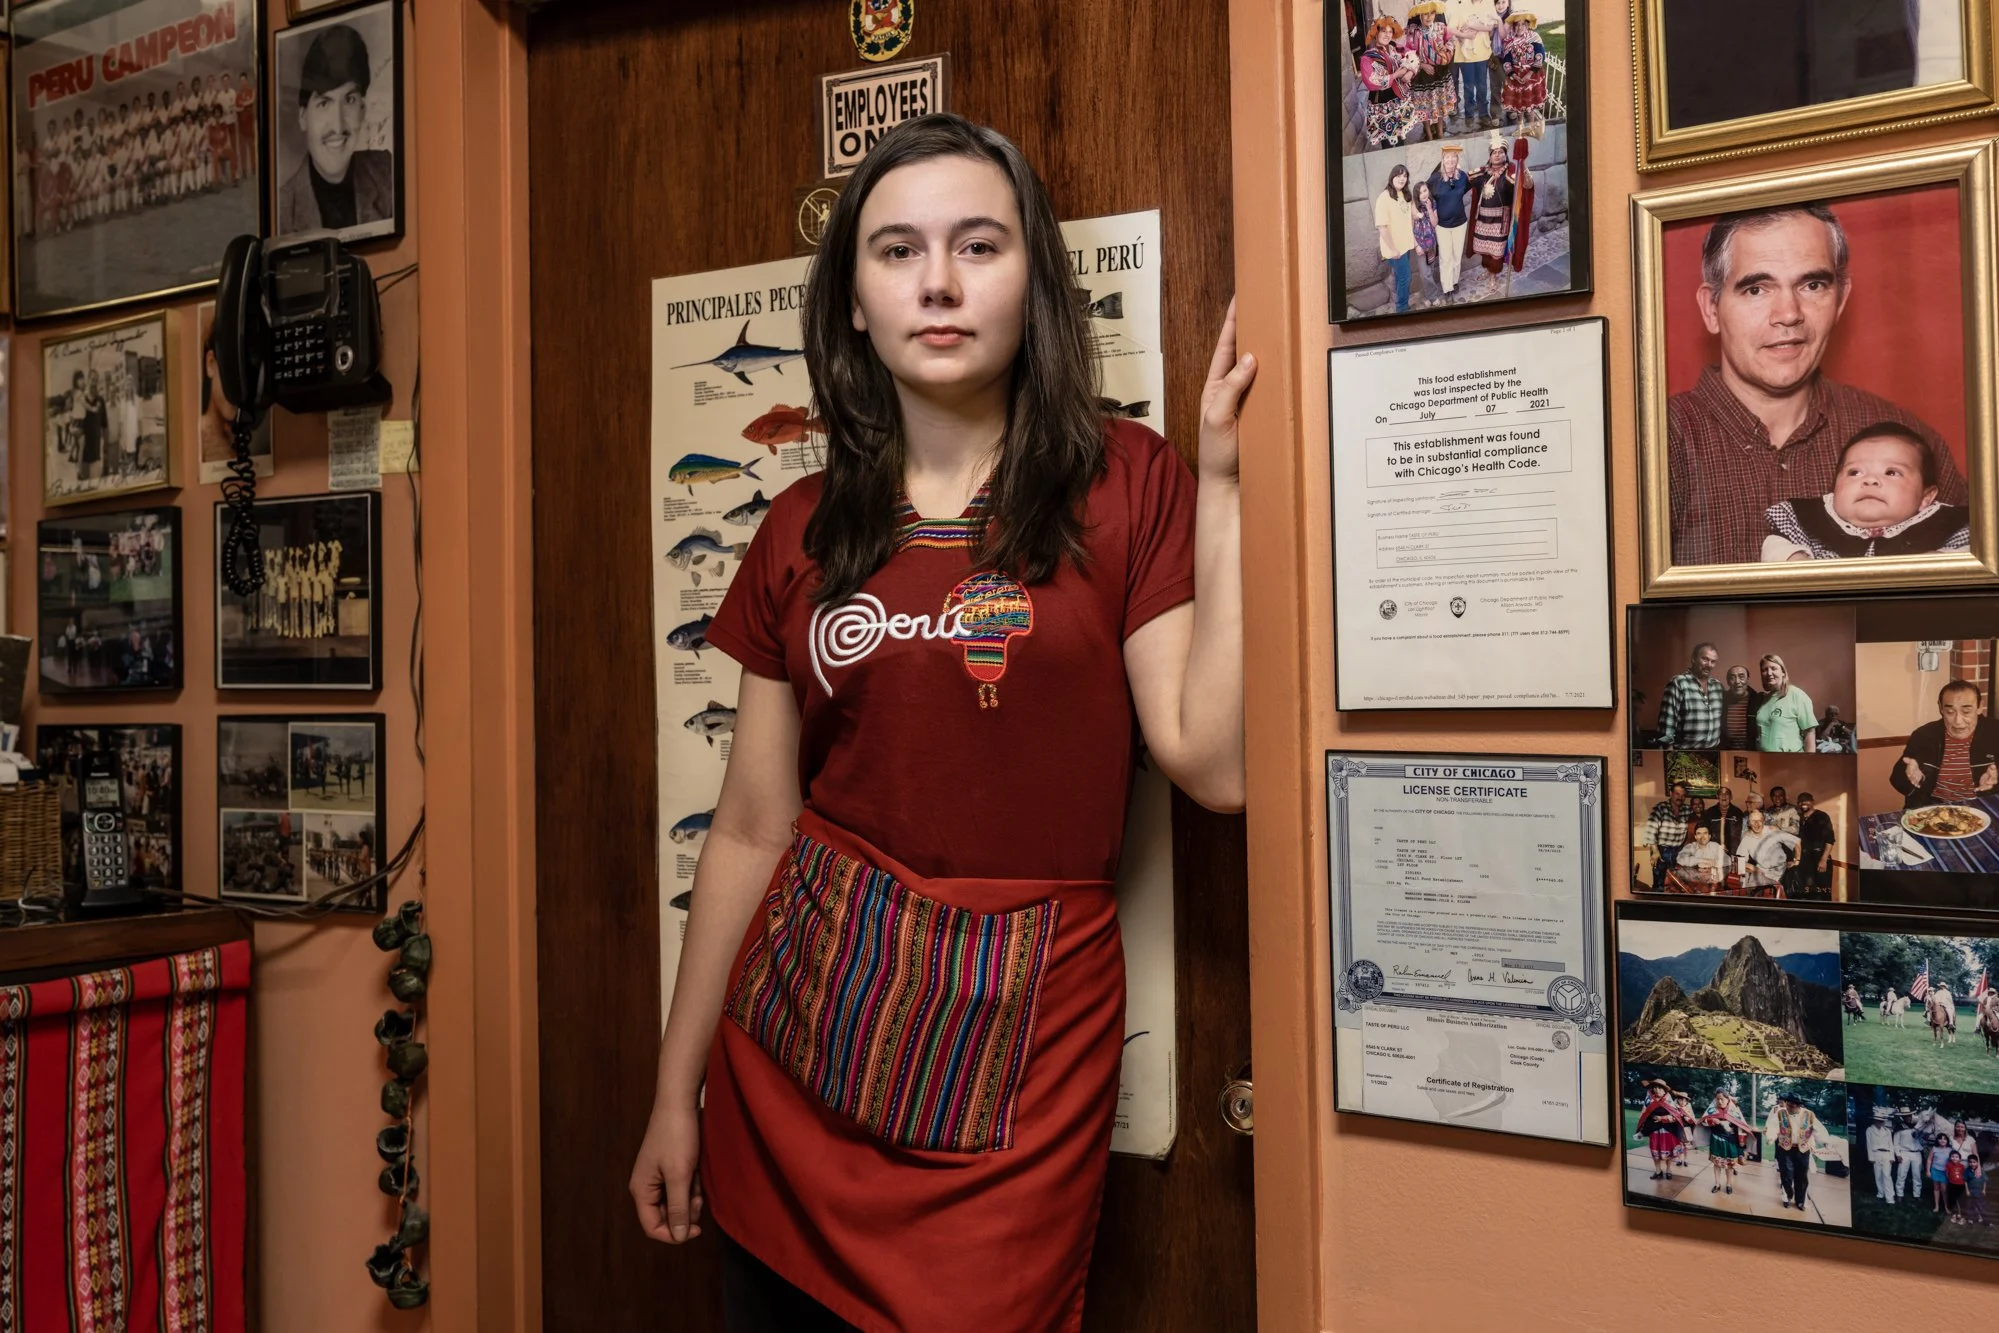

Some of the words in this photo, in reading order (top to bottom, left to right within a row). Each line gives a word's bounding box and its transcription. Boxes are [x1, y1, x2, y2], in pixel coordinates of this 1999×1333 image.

[28, 55, 94, 109] PERU
[102, 3, 237, 83] CAMPEON
[835, 77, 928, 131] EMPLOYEES
[839, 126, 893, 157] ON
[666, 290, 762, 326] PRINCIPALES
[769, 284, 807, 312] PECE
[1067, 249, 1089, 276] EL
[1096, 235, 1145, 274] PERÚ
[1418, 376, 1433, 385] This
[1435, 374, 1454, 383] food
[1457, 367, 1517, 382] establishment
[1414, 389, 1430, 397] was
[1432, 386, 1446, 395] last
[1449, 382, 1491, 395] inspected
[1494, 381, 1505, 391] by
[1507, 378, 1522, 388] the
[1389, 400, 1425, 411] Chicago
[1428, 394, 1478, 407] Department
[1480, 393, 1489, 402] of
[1491, 390, 1517, 401] Public
[1520, 387, 1549, 398] Health
[1375, 415, 1388, 424] On
[1420, 411, 1436, 421] July
[1485, 404, 1496, 413] 07
[1530, 399, 1550, 409] 2021
[1393, 441, 1411, 451] This
[1414, 434, 1484, 450] establishment
[1486, 434, 1507, 443] was
[1509, 429, 1540, 441] found
[1387, 456, 1397, 466] to
[1399, 454, 1413, 465] be
[1416, 454, 1425, 463] in
[1427, 448, 1481, 463] substantial
[1484, 444, 1548, 459] compliance
[1394, 467, 1414, 479] with
[1417, 464, 1469, 477] Chicago's
[1472, 460, 1505, 472] Health
[1508, 458, 1541, 469] Code.
[1413, 767, 1439, 777] CITY
[1443, 767, 1459, 777] OF
[1462, 767, 1516, 779] CHICAGO
[1403, 784, 1451, 796] LICENSE
[1453, 785, 1528, 798] CERTIFICATE
[1436, 796, 1493, 804] NON-TRANSFERABLE
[1446, 1018, 1469, 1026] Business
[1469, 1021, 1508, 1030] Authorization
[1426, 1076, 1461, 1087] Certificate
[1462, 1080, 1471, 1088] of
[1471, 1081, 1515, 1094] Registration
